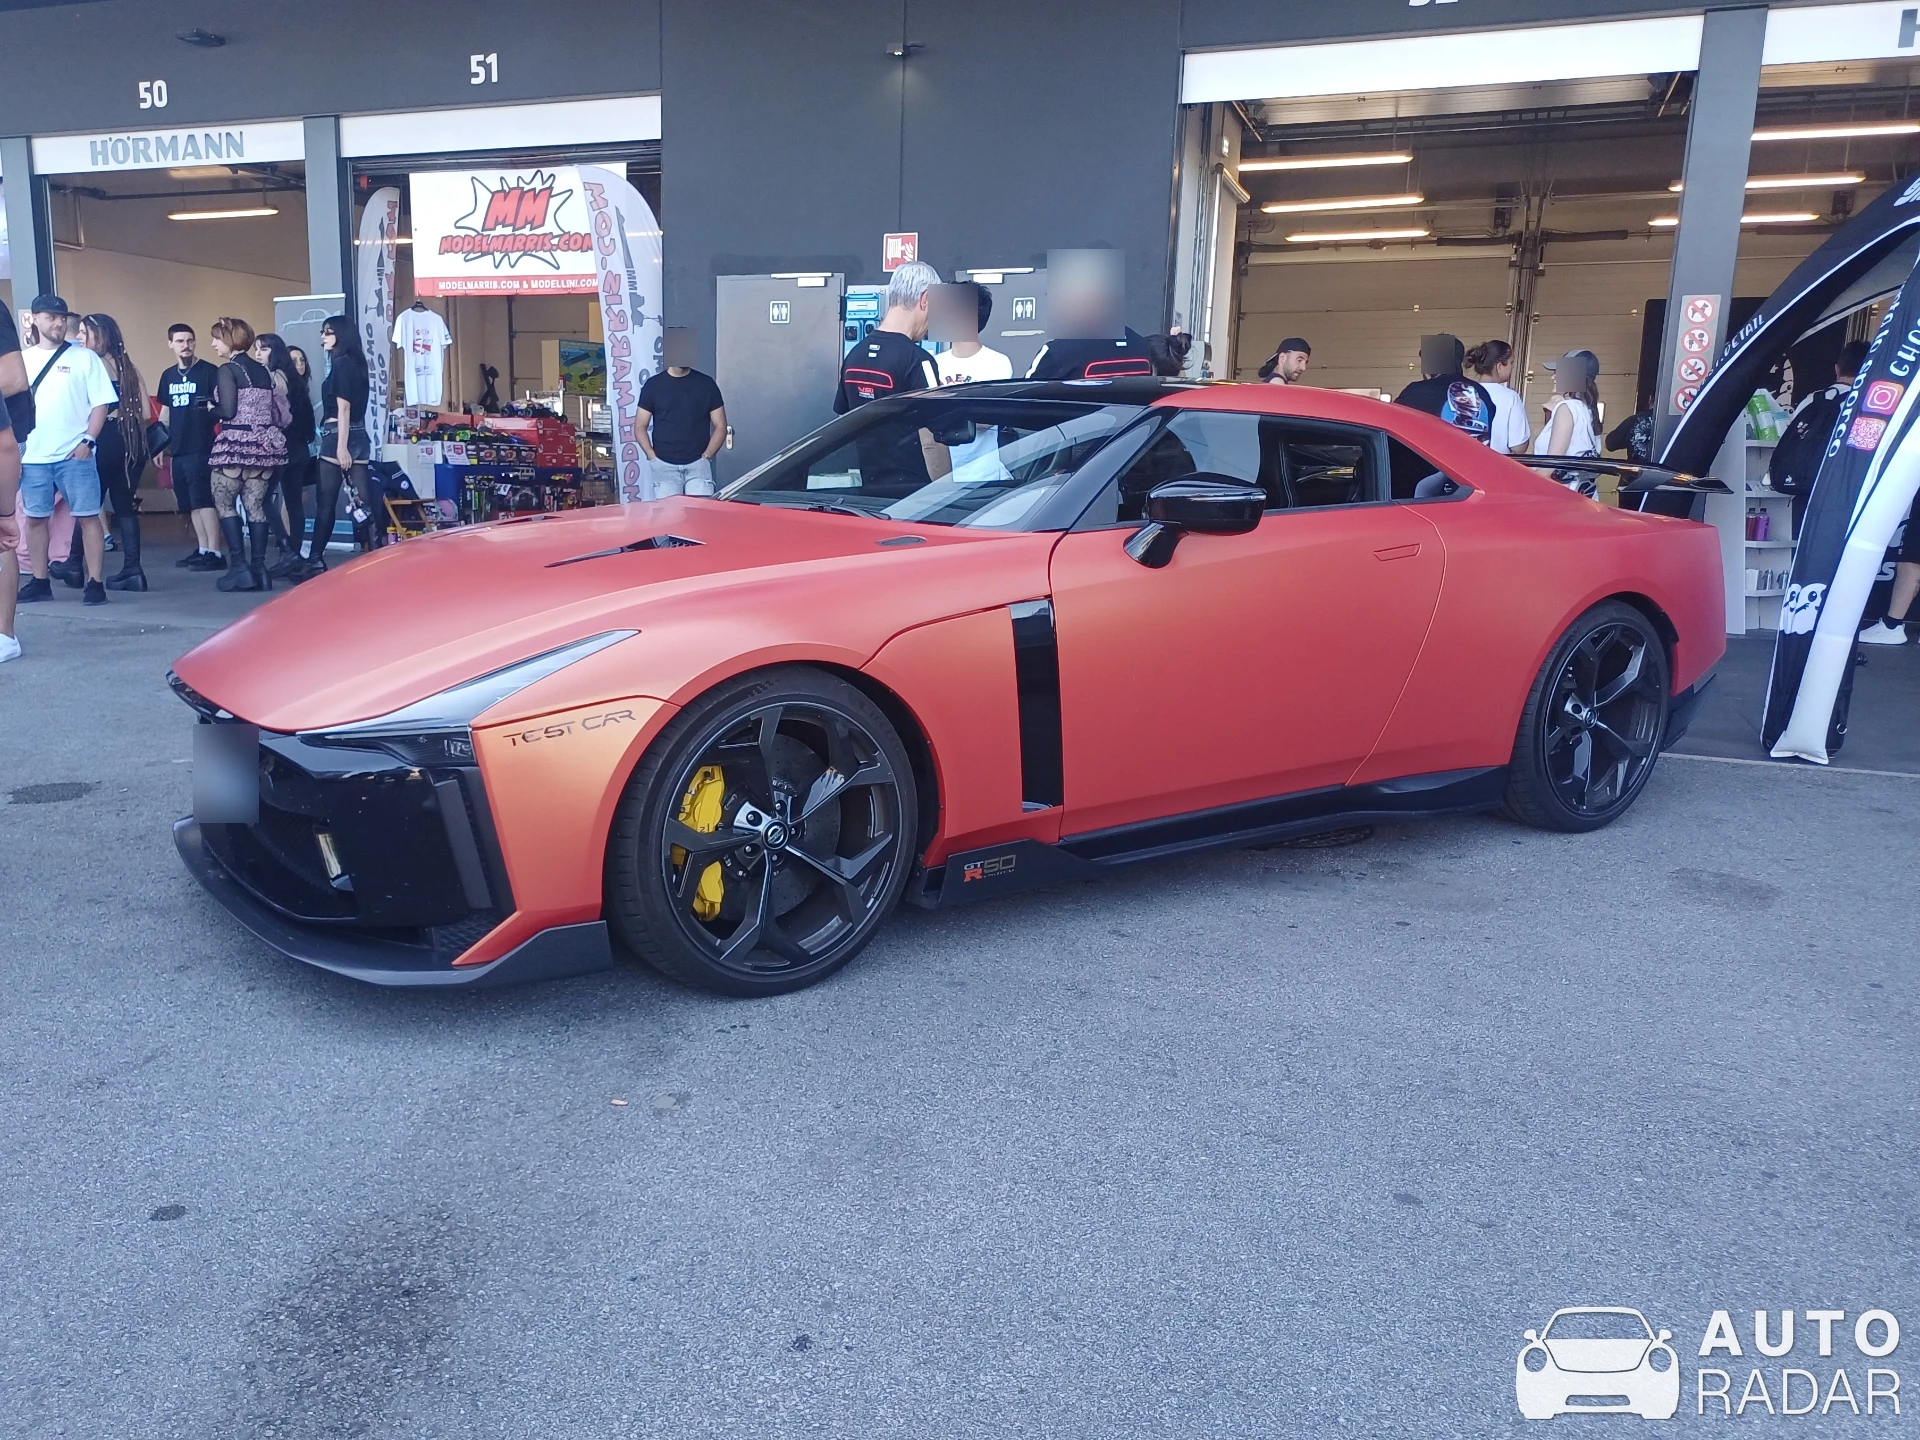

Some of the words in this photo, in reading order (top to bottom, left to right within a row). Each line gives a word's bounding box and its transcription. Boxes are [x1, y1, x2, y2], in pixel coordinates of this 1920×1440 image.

[470, 53, 499, 84] 51
[138, 80, 168, 109] 50
[89, 130, 245, 166] HÖRMANN
[481, 187, 553, 232] MM
[438, 231, 594, 255] MODELMARRIS.COM
[438, 280, 520, 290] MODELMARRIS.COM
[523, 280, 529, 289] &
[531, 279, 598, 289] MODELLINI.COM
[1889, 317, 1920, 377] GHO
[503, 721, 575, 747] TEST
[582, 709, 637, 731] CAR
